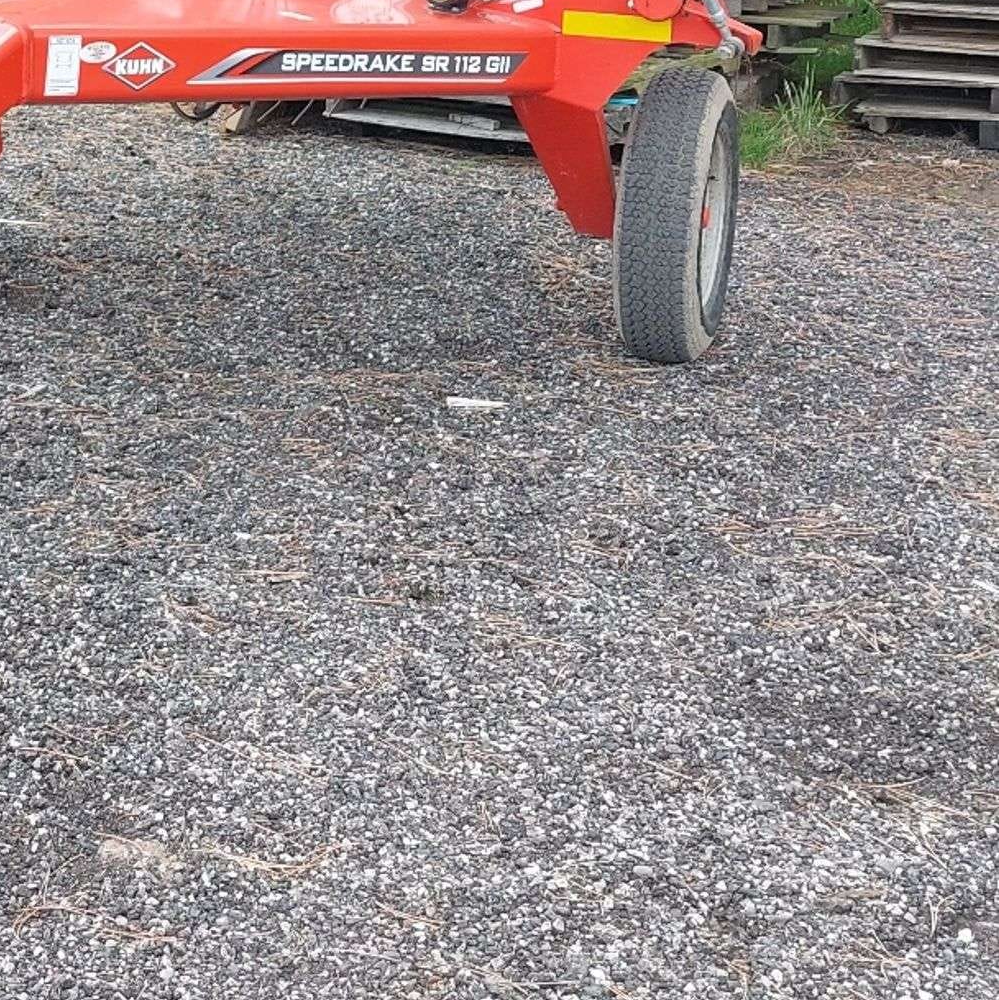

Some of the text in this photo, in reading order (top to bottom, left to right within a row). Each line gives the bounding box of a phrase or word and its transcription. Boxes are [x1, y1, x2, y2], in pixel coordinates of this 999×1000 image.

[115, 57, 164, 76] KUHN
[281, 52, 511, 74] SPEEDRAKE SR 112 GII
